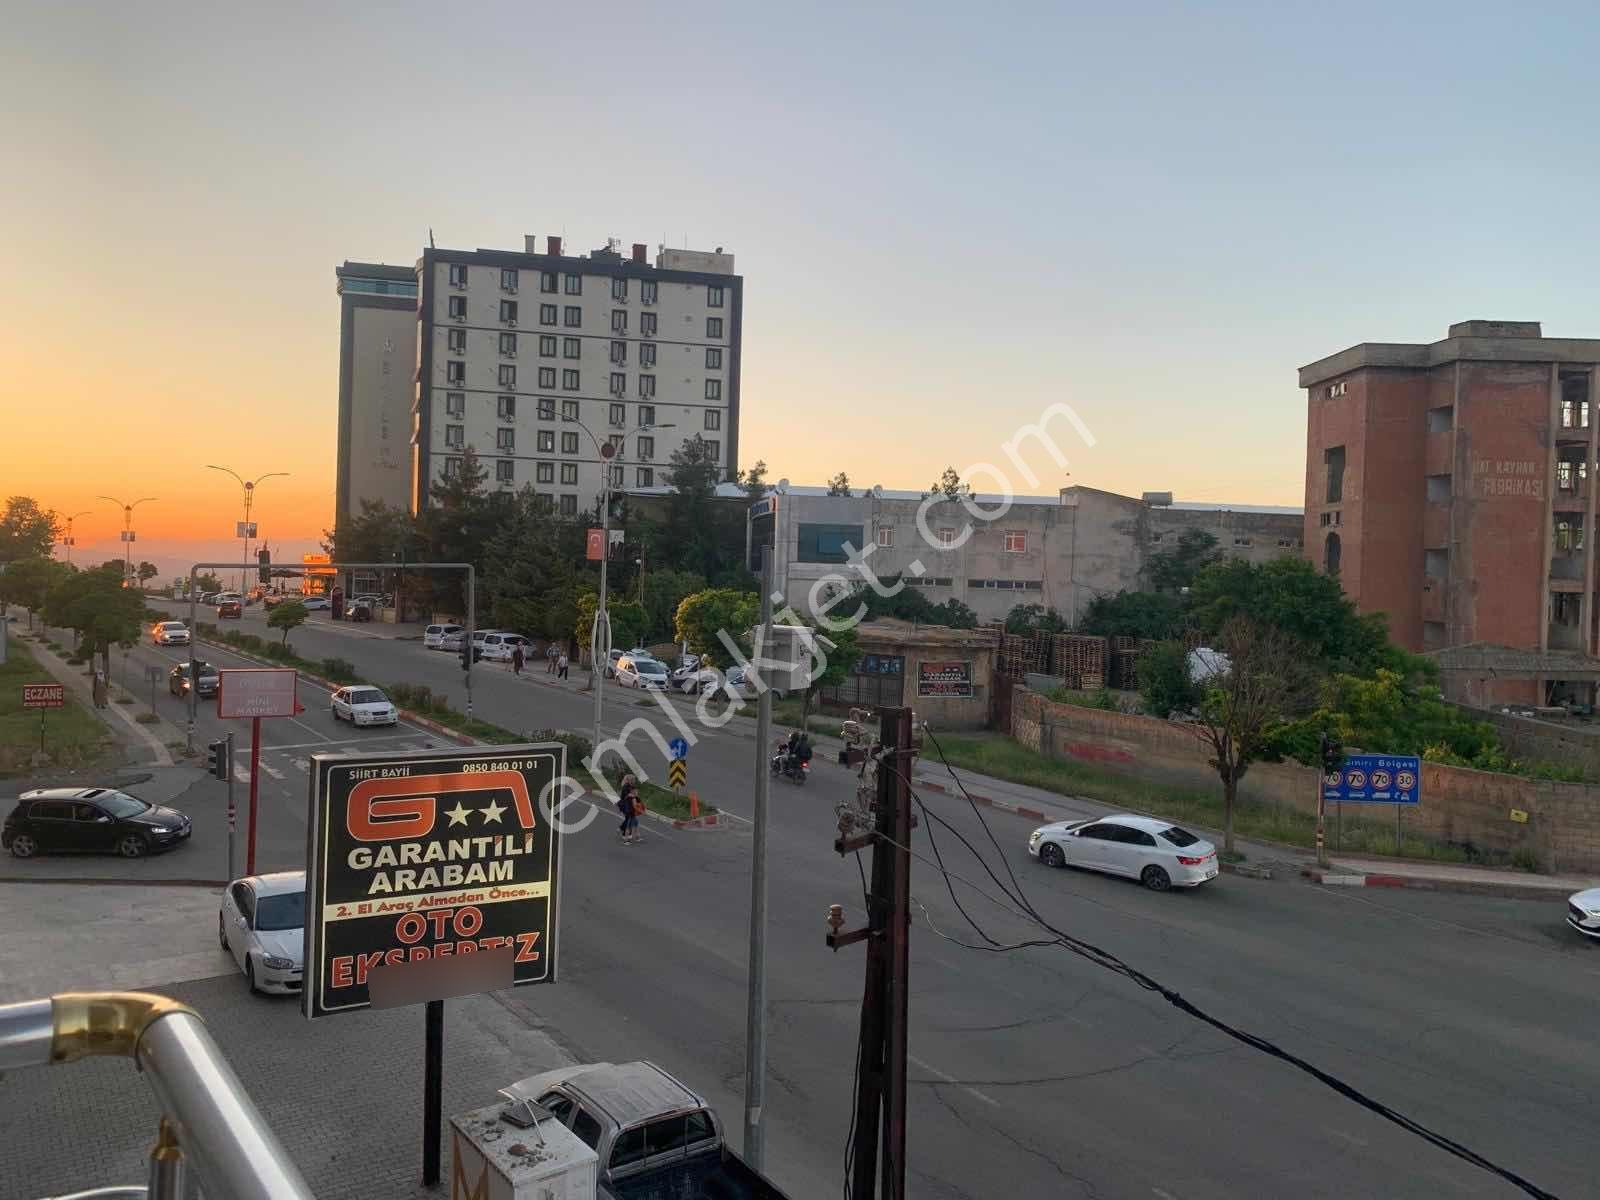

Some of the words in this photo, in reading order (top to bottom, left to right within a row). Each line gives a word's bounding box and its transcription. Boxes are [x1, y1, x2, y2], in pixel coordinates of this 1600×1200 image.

[24, 688, 63, 700] ECZANE
[463, 764, 488, 773] 0850
[491, 762, 509, 771] 840
[512, 761, 523, 770] 01
[526, 760, 538, 769] 01
[347, 832, 535, 870] GARANTİLİ
[367, 859, 514, 895] ARABAM
[336, 906, 353, 918] 2.
[357, 904, 373, 915] El
[376, 901, 415, 913] Araç
[418, 892, 484, 908] Almadan
[395, 906, 483, 944] OTO
